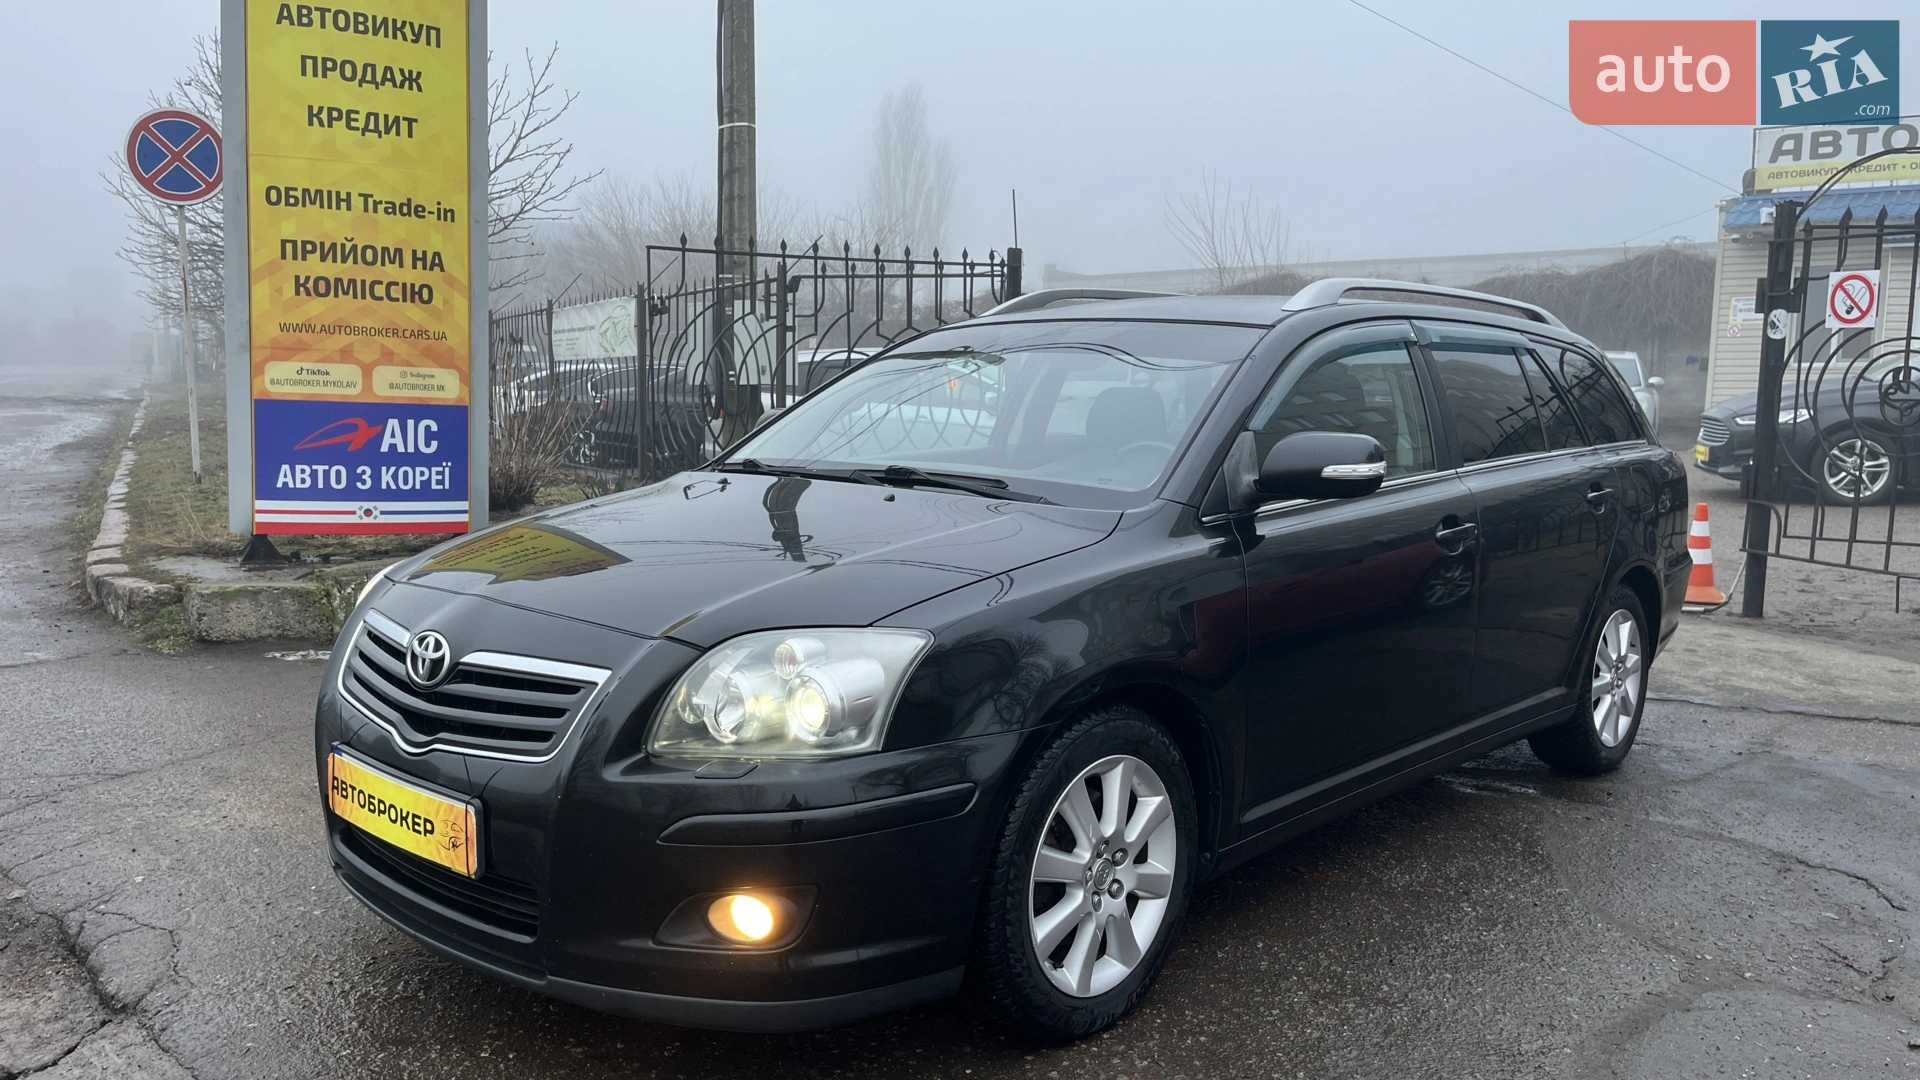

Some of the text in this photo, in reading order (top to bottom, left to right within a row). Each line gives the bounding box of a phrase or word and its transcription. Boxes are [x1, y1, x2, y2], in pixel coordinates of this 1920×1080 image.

[276, 3, 441, 49] АВТОВИКУП
[300, 54, 423, 93] ПРОДАЖ
[307, 104, 418, 139] КРЕДИТ
[1767, 167, 1839, 181] АВТОВИКУП
[265, 185, 456, 224] ОБМІН Trade-in
[280, 236, 445, 272] ПРИЙОМ НА
[294, 275, 434, 305] КОМІССІЮ
[279, 322, 448, 342] WWW.AUTOBROKER.CARS.UA
[269, 378, 358, 389] @AUTOBROKER.MYKOLAIV
[305, 368, 331, 377] TikTok
[388, 382, 446, 392] @AUTOBROKER.MK
[409, 371, 436, 380] Instagram
[276, 464, 347, 489] АВТО
[381, 462, 451, 490] КОРЕЇ
[332, 775, 435, 838] АВТОБРОКЕР
